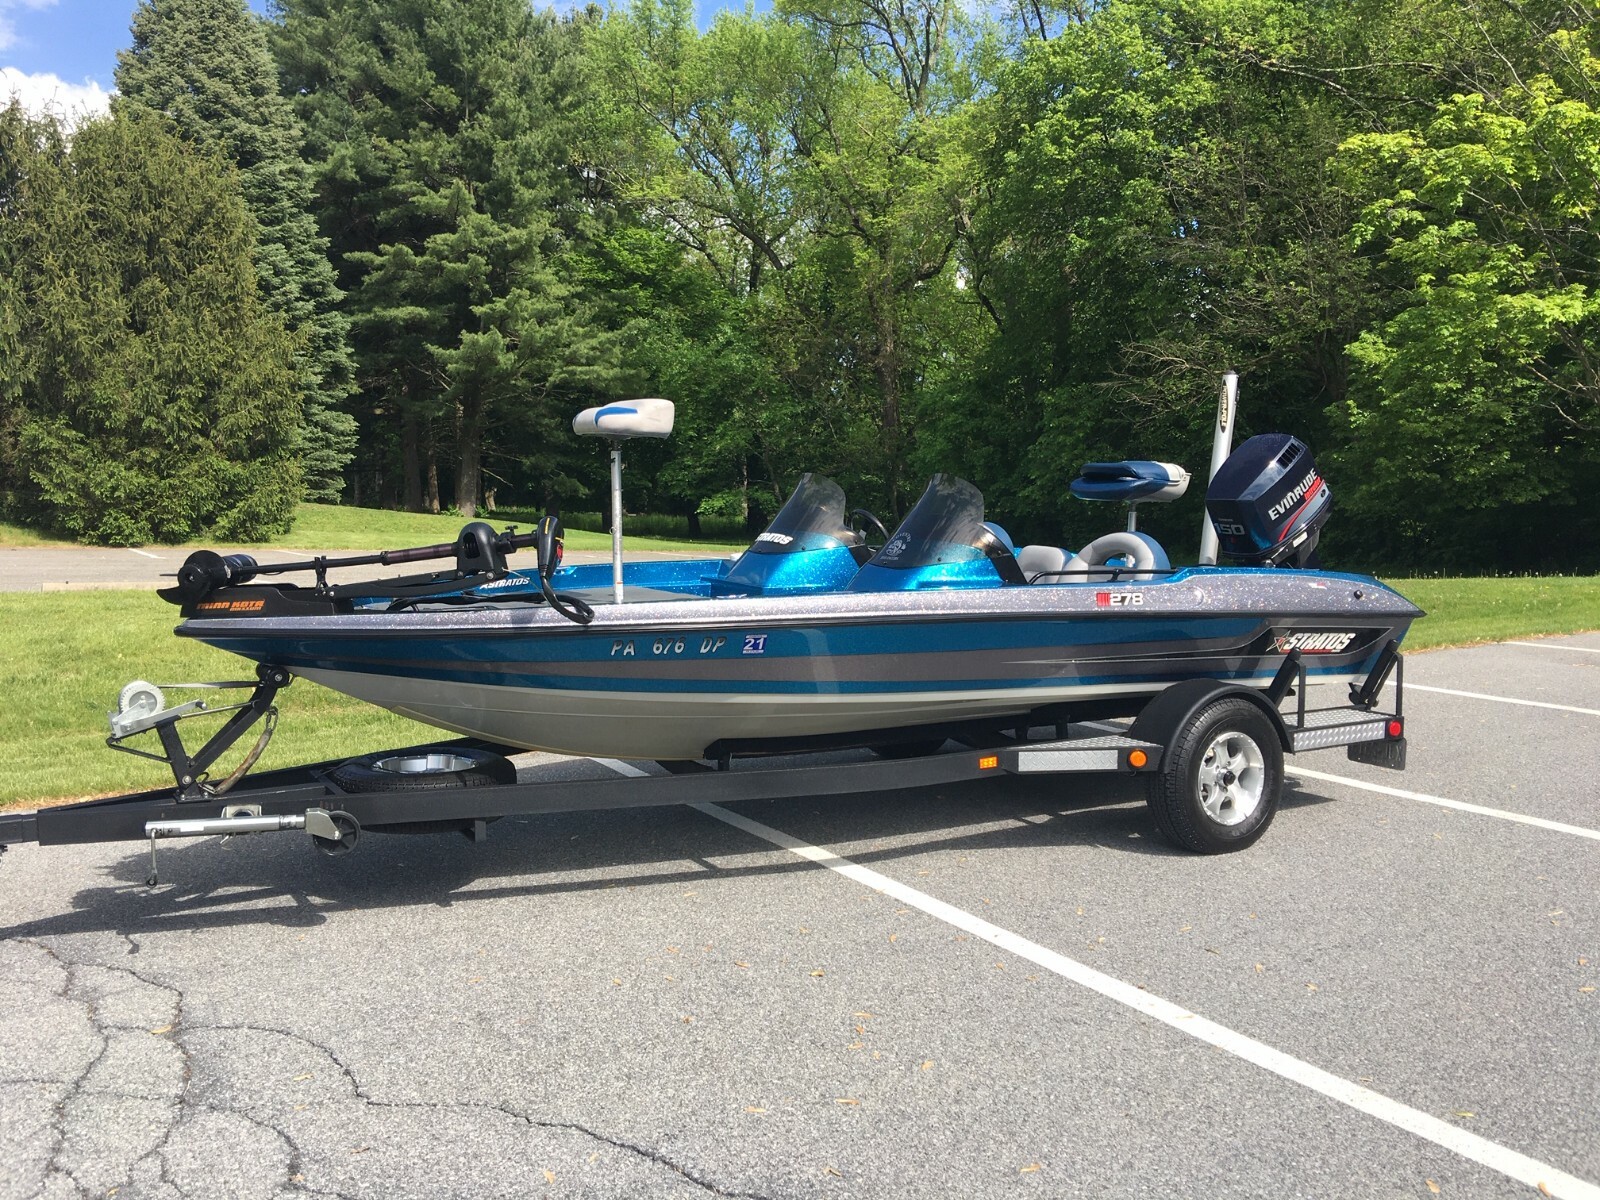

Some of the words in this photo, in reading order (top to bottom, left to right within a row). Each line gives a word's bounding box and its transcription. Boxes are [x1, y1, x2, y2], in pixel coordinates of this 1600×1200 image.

[1268, 468, 1317, 520] EVINRUDE
[1214, 523, 1245, 535] 150
[487, 577, 531, 588] STRATOS
[231, 600, 265, 610] KOTA
[1109, 592, 1144, 606] 278
[610, 639, 636, 656] PA
[652, 636, 687, 655] 676
[699, 635, 728, 654] DP
[743, 637, 765, 650] 21
[1285, 632, 1355, 651] STRATOS
